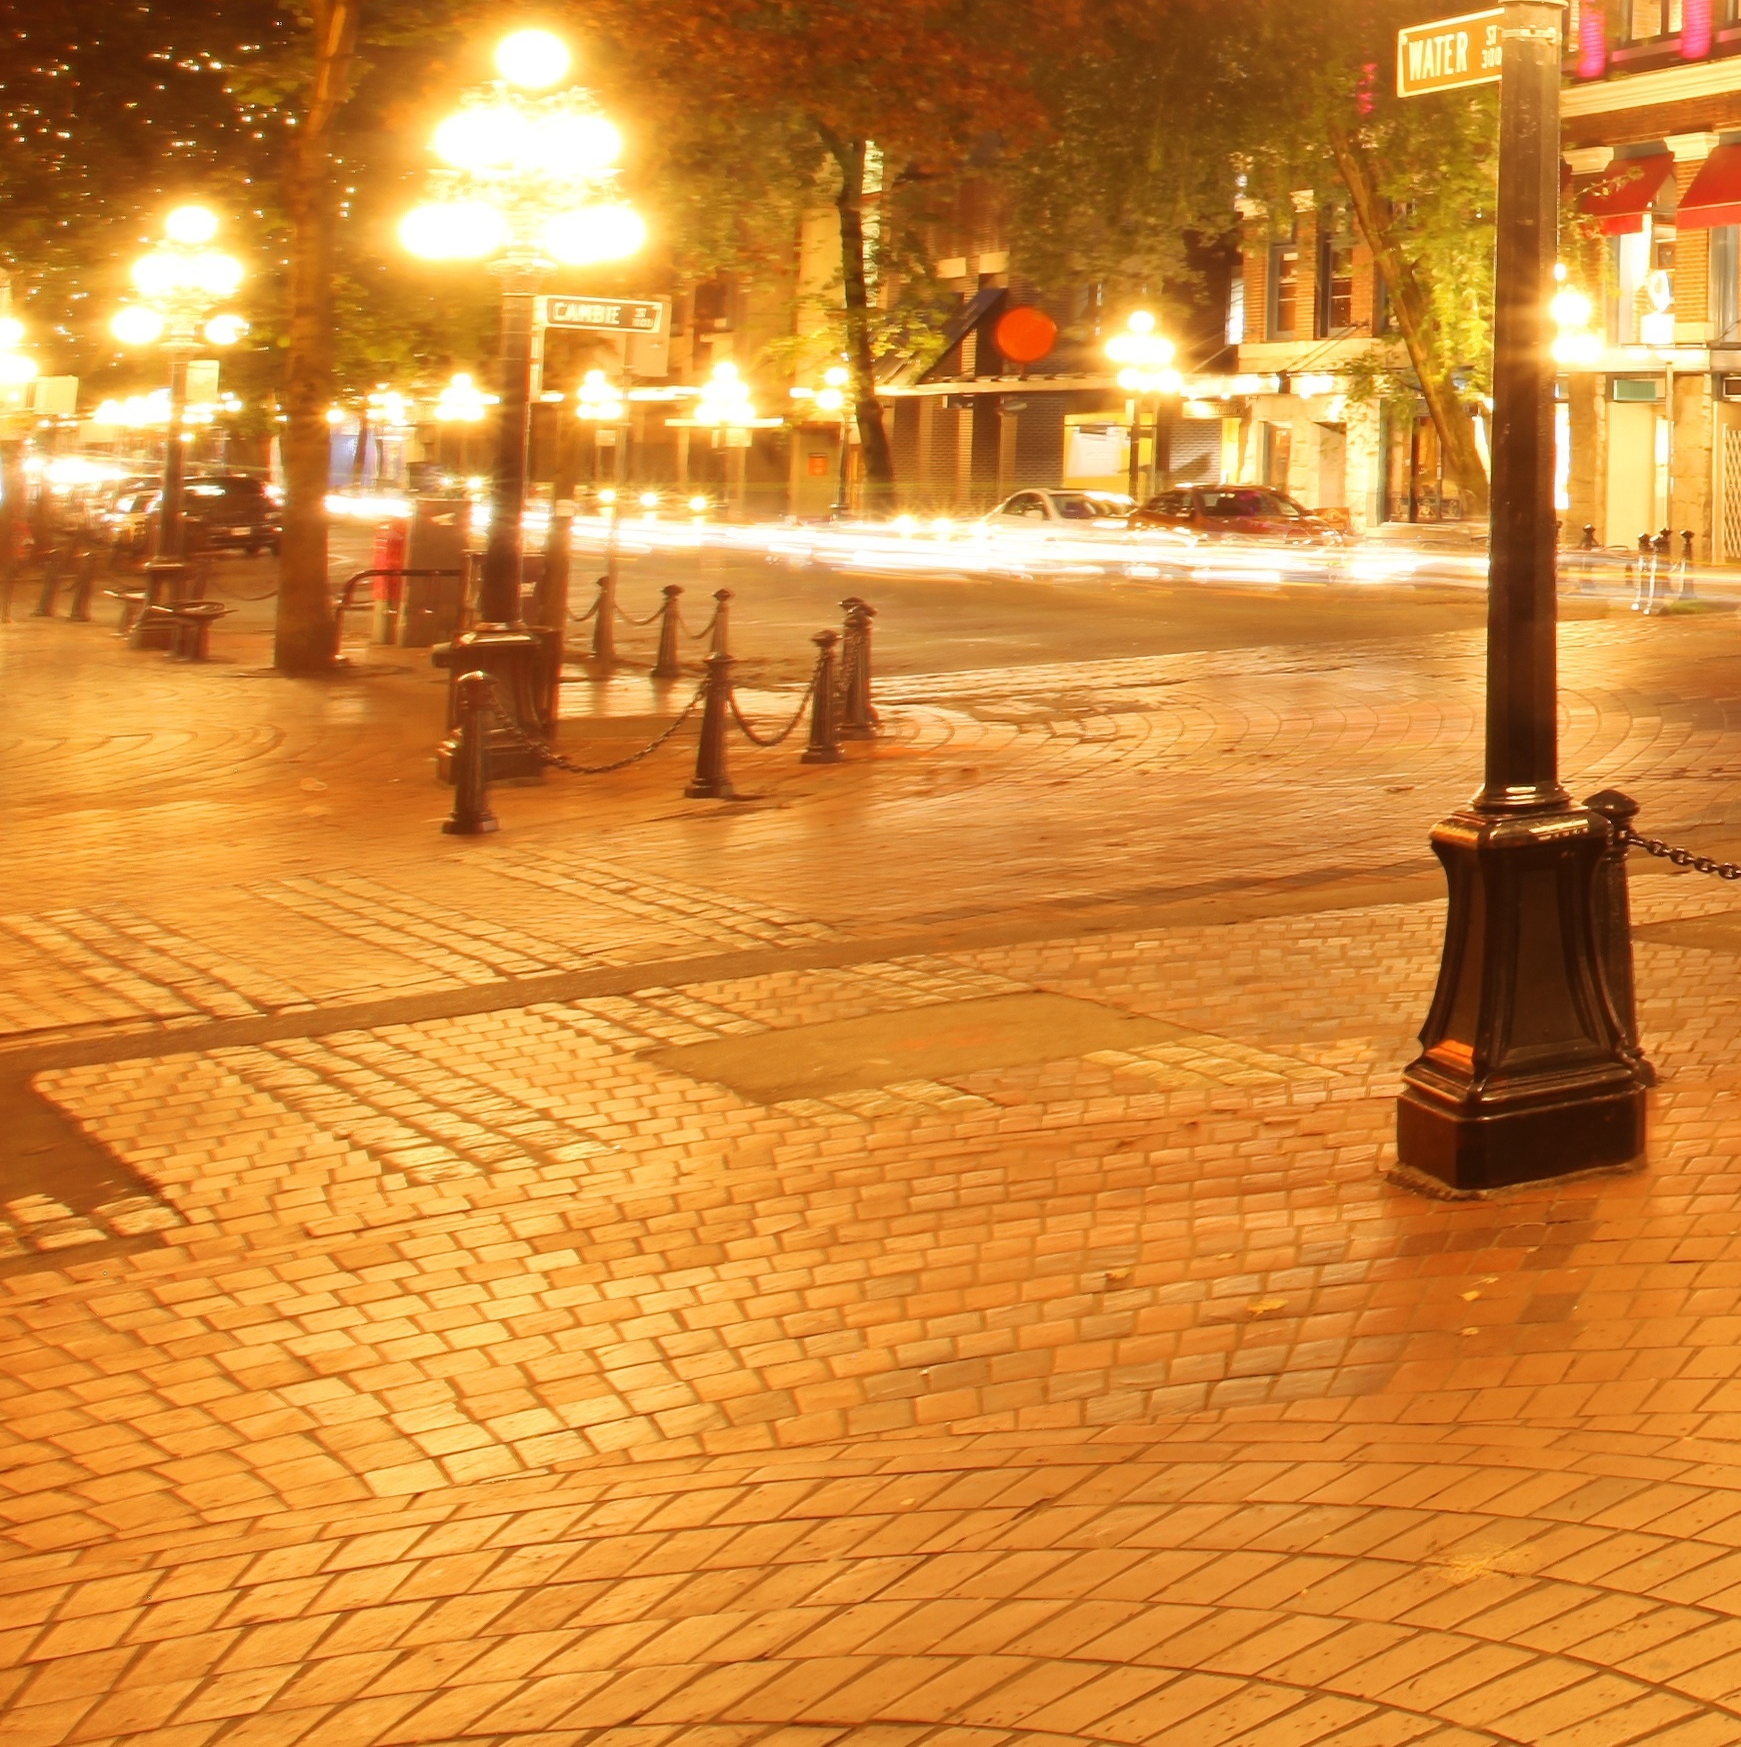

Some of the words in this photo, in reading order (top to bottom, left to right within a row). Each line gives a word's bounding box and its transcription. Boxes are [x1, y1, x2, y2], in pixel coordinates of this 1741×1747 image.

[1409, 31, 1469, 82] WATER
[1486, 25, 1498, 46] ST
[1481, 46, 1502, 69] 300
[553, 301, 621, 325] CAMBIE
